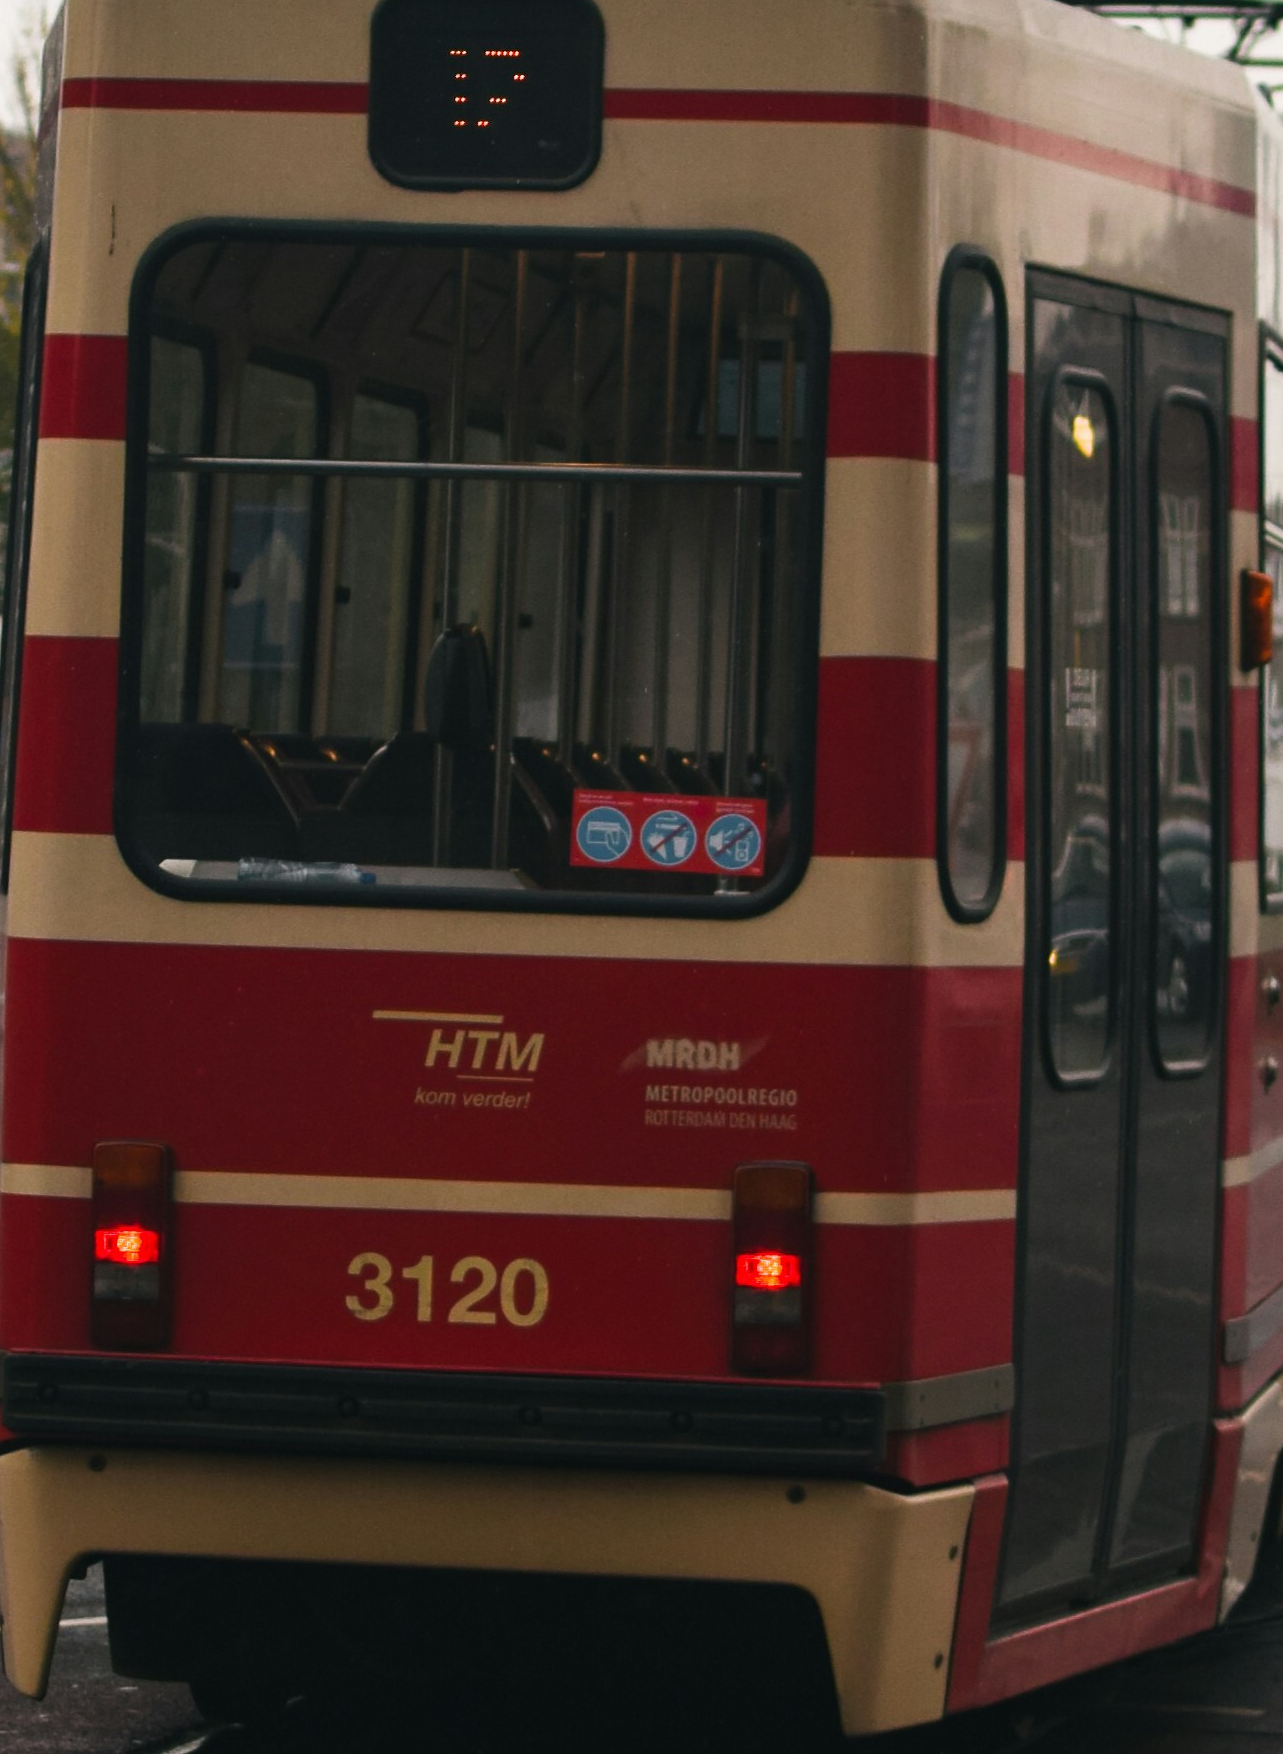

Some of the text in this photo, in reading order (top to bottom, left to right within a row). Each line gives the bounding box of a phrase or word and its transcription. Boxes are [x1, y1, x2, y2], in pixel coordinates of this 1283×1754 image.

[424, 1028, 546, 1073] HTM
[646, 1038, 741, 1071] MRDH
[414, 1087, 532, 1109] kom verder!
[645, 1085, 798, 1107] METROPOOLREGIO
[644, 1108, 798, 1131] ROTTERDAM DEN HAAG
[345, 1251, 549, 1327] 3120
